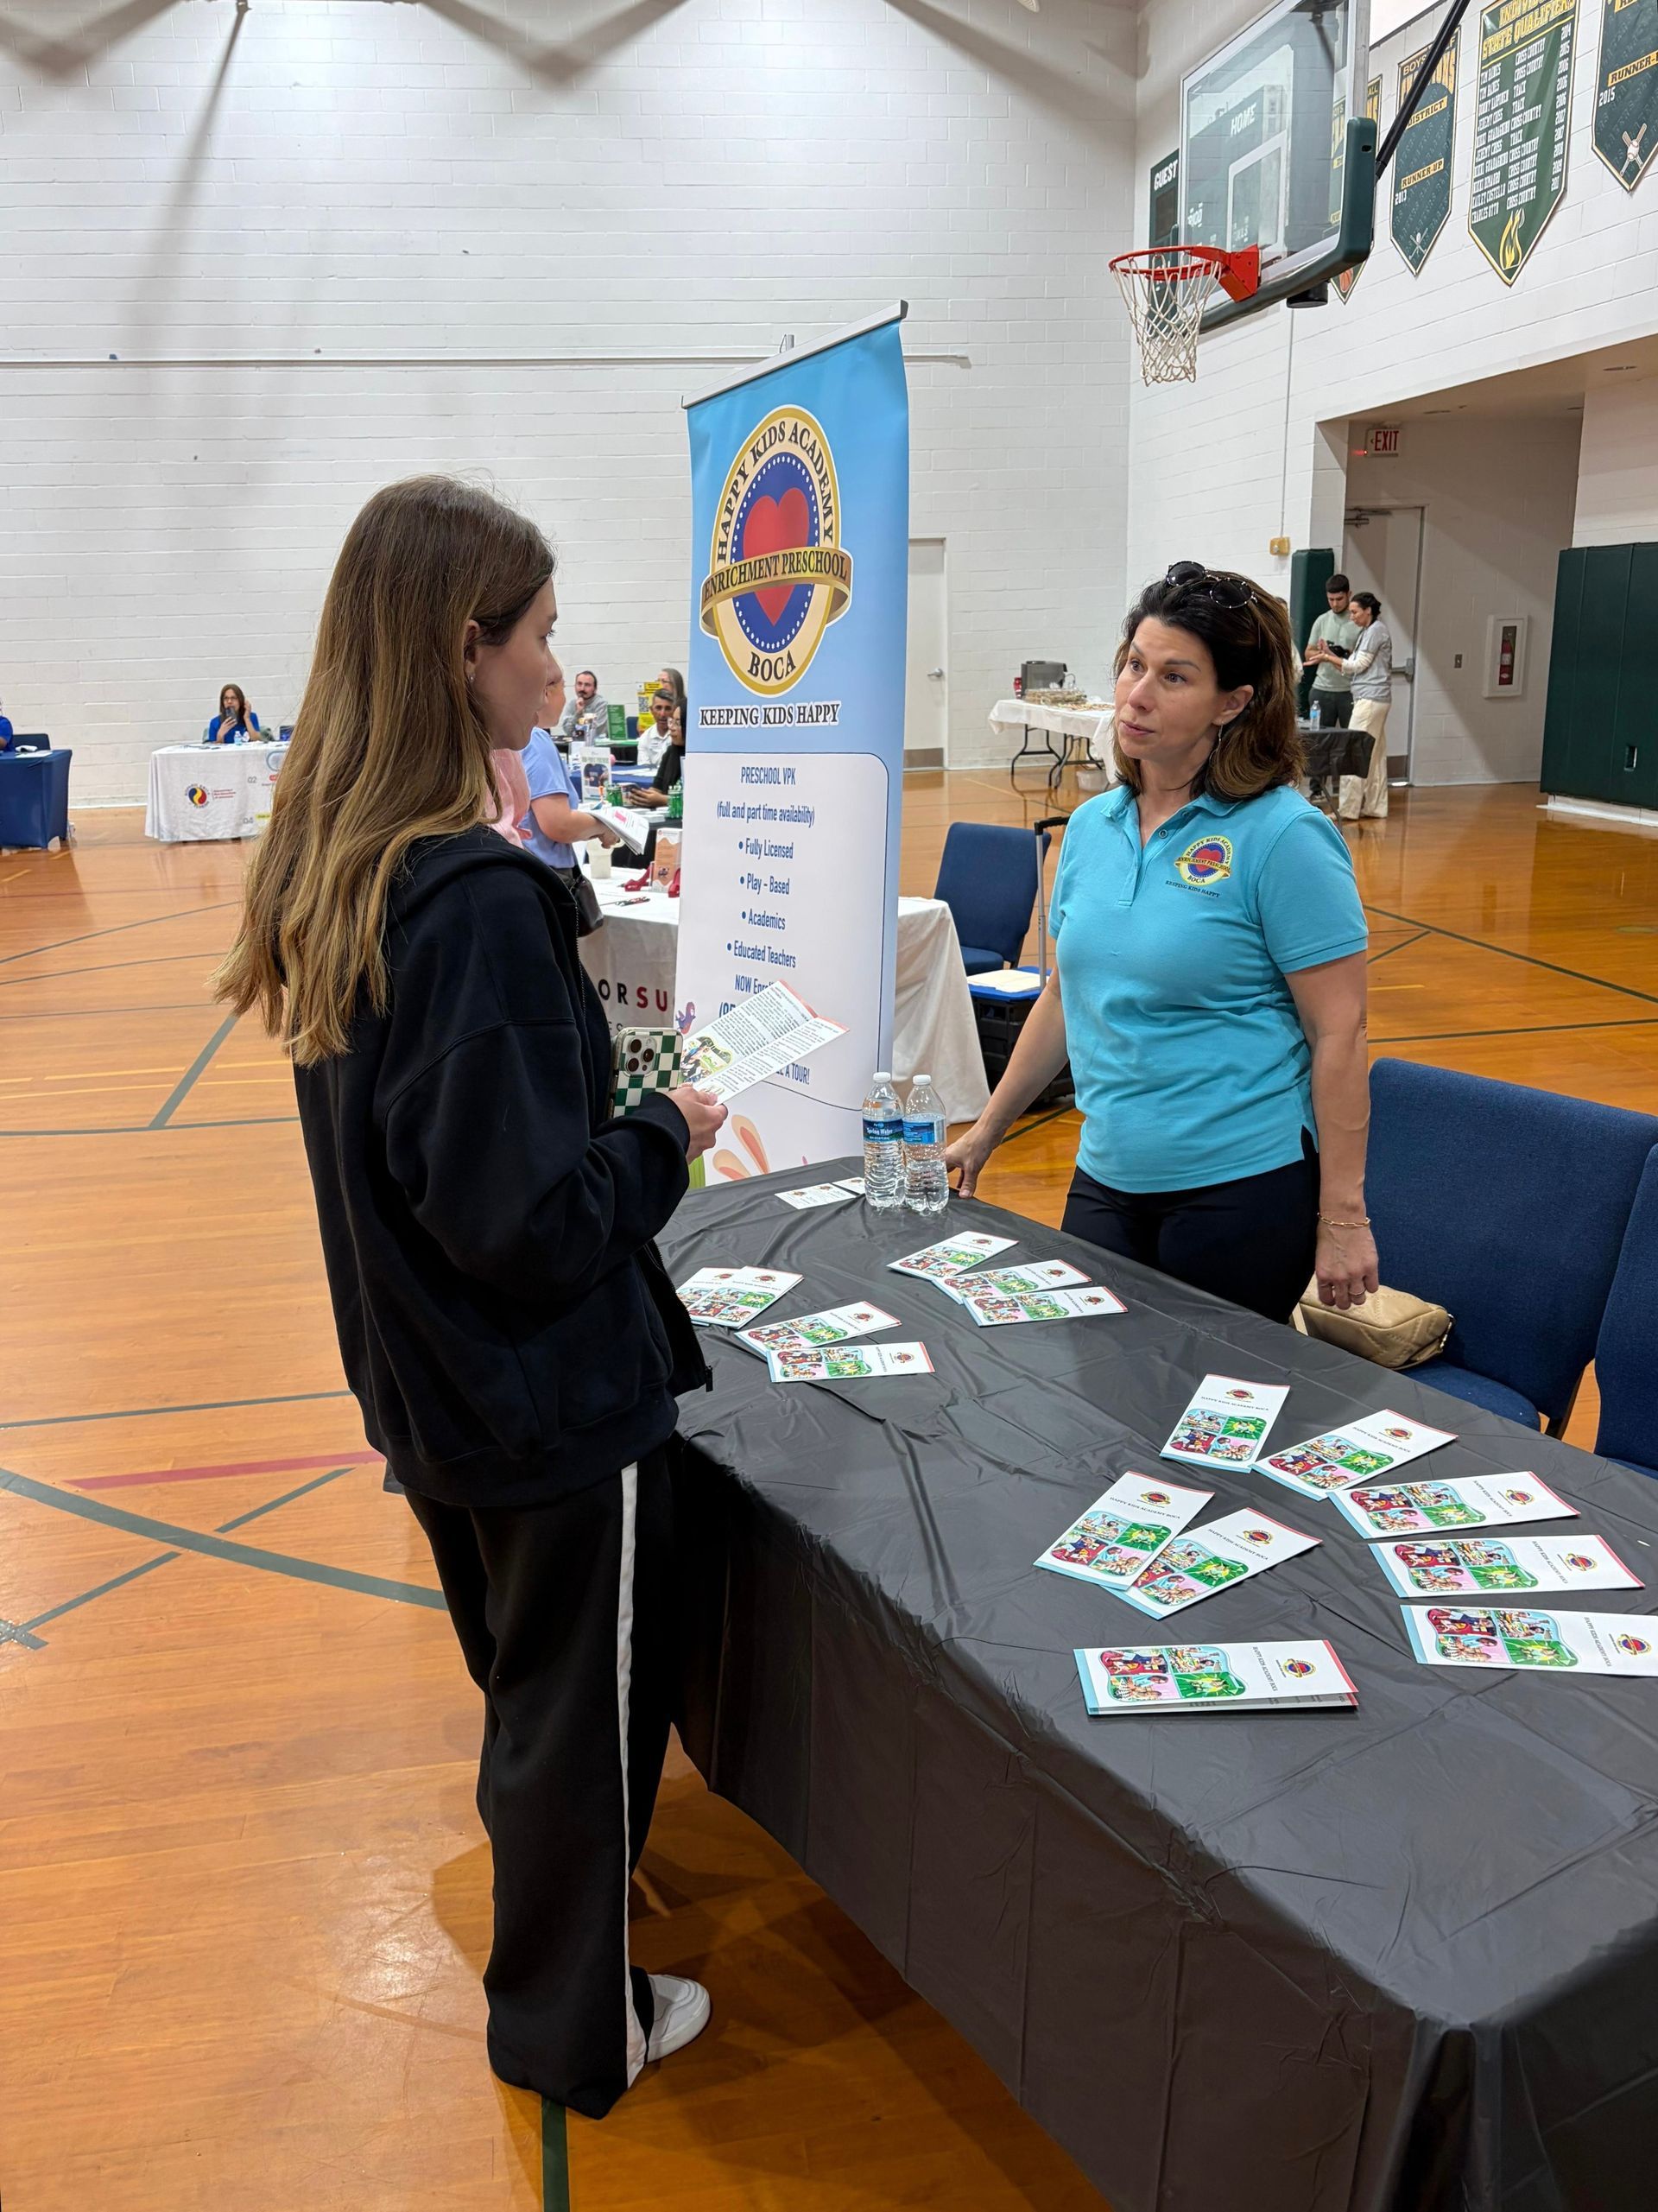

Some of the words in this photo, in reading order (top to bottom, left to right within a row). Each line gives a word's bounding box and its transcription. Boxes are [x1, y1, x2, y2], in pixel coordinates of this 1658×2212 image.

[1482, 23, 1513, 60] STATE
[1515, 49, 1527, 66] CROSS
[1528, 38, 1546, 60] COUNTRY
[1514, 65, 1526, 82] CROSS
[1527, 54, 1544, 76] COUNTRY
[1611, 52, 1658, 84] RUNNER-
[1598, 86, 1616, 107] 2015
[1231, 103, 1257, 138] HOME
[1510, 112, 1522, 130] CROSS
[1522, 104, 1541, 124] COUNTRY
[1509, 145, 1521, 163] CROSS
[1522, 136, 1539, 157] COUNTRY
[1154, 159, 1179, 191] GUEST
[1402, 161, 1443, 187] RUNNER-UP
[1509, 162, 1520, 179] CROSS
[1520, 153, 1537, 173] COUNTRY
[1508, 177, 1519, 193] CROSS
[1520, 169, 1537, 188] COUNTRY
[1395, 189, 1407, 206] 2013
[1506, 193, 1518, 210] CROSS
[1519, 186, 1536, 206] COUNTRY
[1374, 430, 1399, 452] EXIT
[718, 460, 749, 564] HAPPY
[750, 421, 786, 466] KIDS
[788, 421, 833, 543] ACADEMY
[704, 555, 779, 603] ENRICHMENT
[782, 549, 847, 581] PRESCHOOL
[748, 650, 796, 681] BOCA
[699, 708, 759, 726] KEEPING
[763, 706, 794, 725] KIDS
[796, 703, 840, 724] HAPPY
[741, 766, 781, 784] PRESCHOOL
[782, 768, 796, 785] VPK
[717, 801, 731, 819] (full
[732, 802, 745, 819] and
[746, 805, 762, 823] part
[763, 803, 777, 821] time
[779, 804, 815, 828] availability)
[745, 838, 763, 860] Fully
[763, 840, 794, 859] Licensed
[1186, 840, 1205, 857] HAPPY
[746, 872, 762, 895] Play
[769, 875, 790, 895] Based
[1165, 880, 1187, 890] KEEPING
[1201, 889, 1221, 898] HAPPY
[1187, 874, 1206, 884] BOCA
[748, 909, 786, 930] Academics
[734, 940, 766, 962] Educated
[767, 946, 796, 968] Teachers
[734, 973, 752, 992] NOW
[792, 1062, 810, 1086] TOUR!
